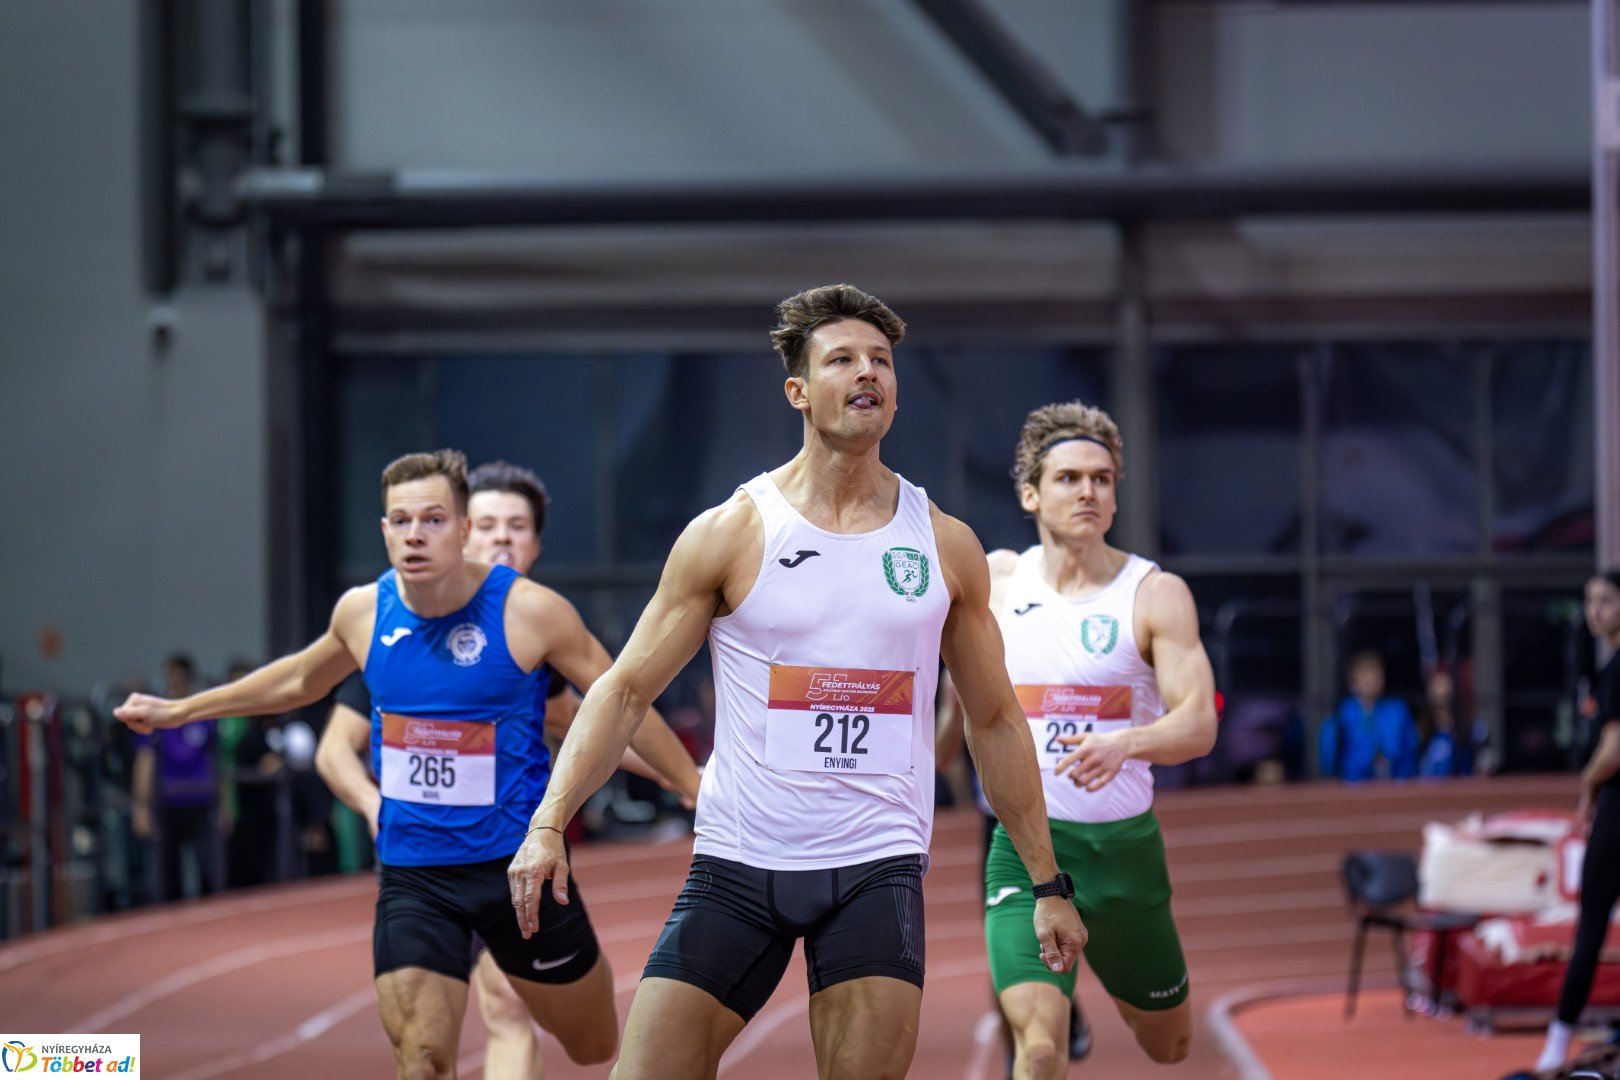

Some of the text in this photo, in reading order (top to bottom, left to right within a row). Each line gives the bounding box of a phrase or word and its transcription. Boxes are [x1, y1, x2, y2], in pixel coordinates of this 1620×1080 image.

[821, 681, 881, 691] FEDETTPÁLYÁS
[809, 703, 859, 712] NYÍREGYHÁZA
[813, 713, 870, 755] 212
[824, 757, 857, 770] ENYINGI
[409, 755, 456, 789] 265
